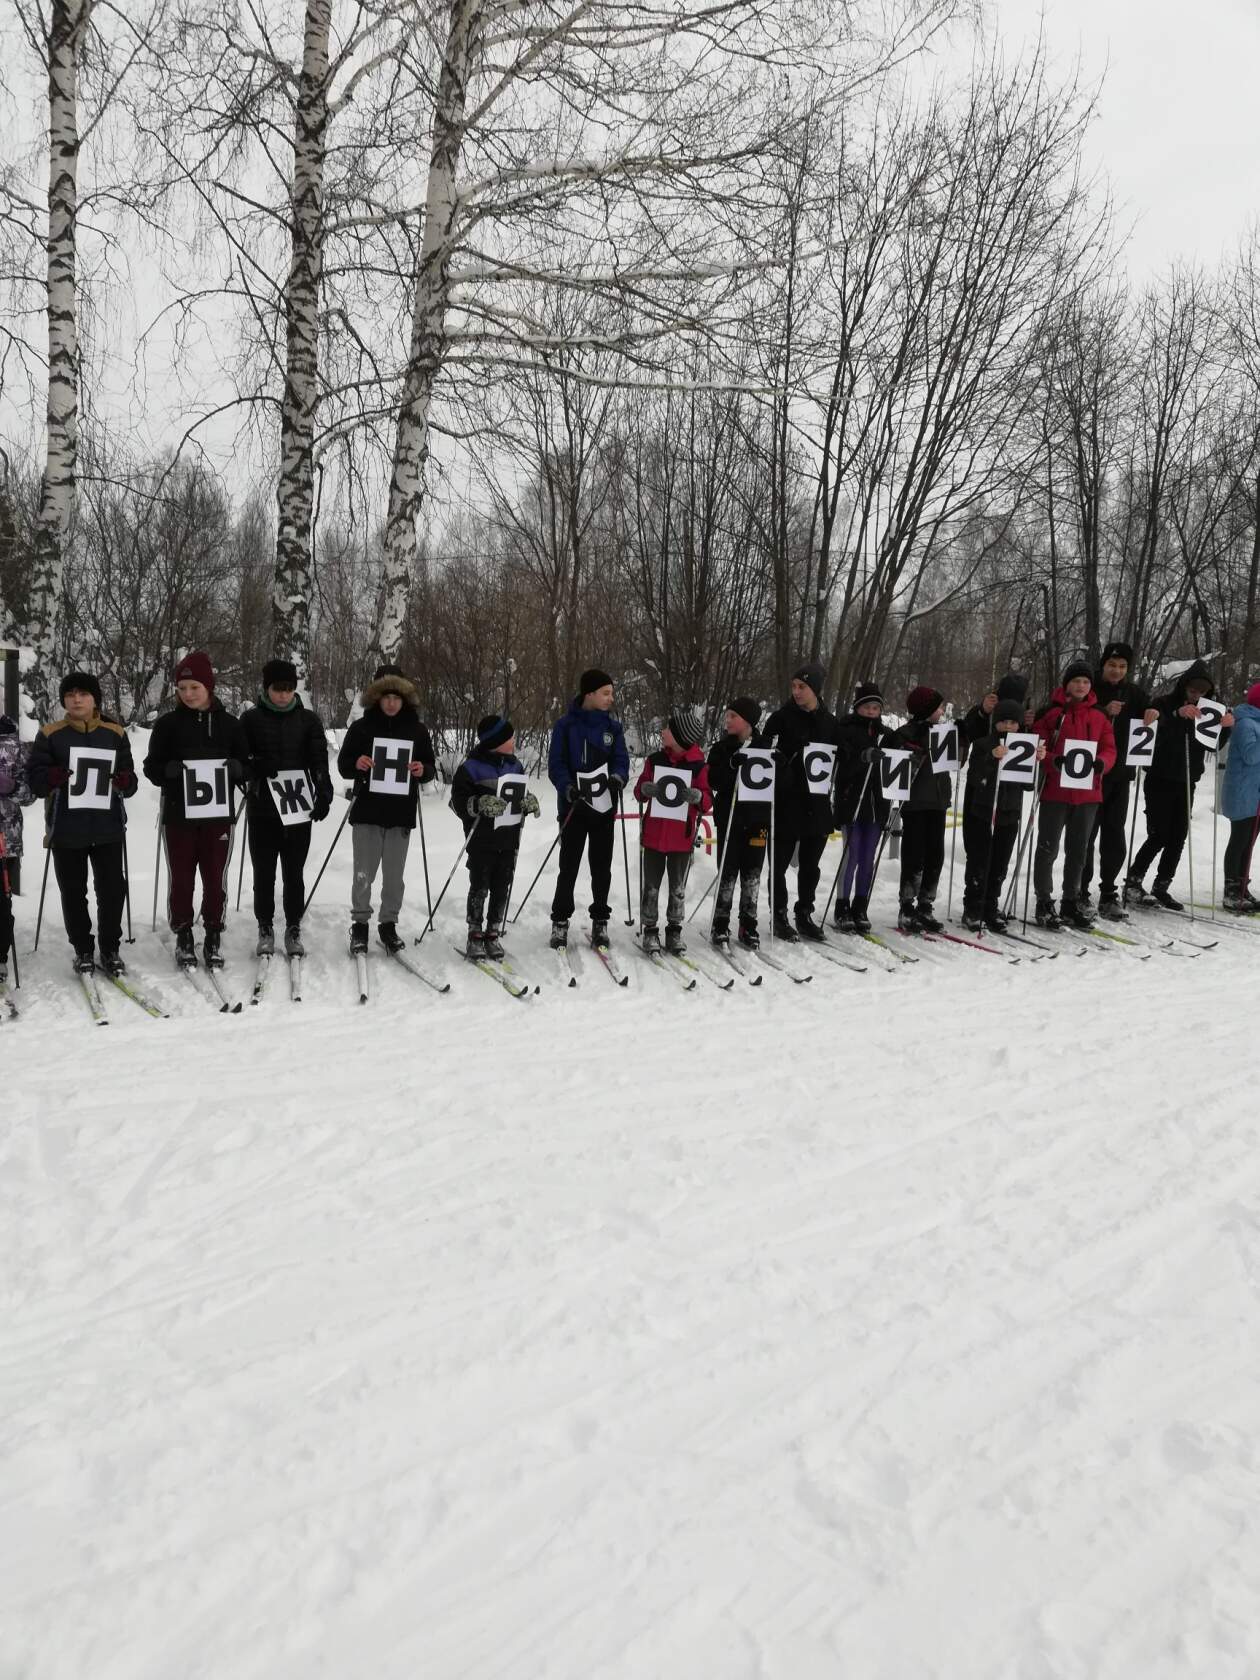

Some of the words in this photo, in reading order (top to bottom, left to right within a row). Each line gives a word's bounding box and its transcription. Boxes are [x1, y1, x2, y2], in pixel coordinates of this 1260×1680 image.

[1196, 708, 1221, 737] 2
[930, 731, 957, 761] И
[1003, 741, 1035, 770] 2
[1130, 728, 1154, 755] 2
[71, 757, 111, 796] Л
[374, 746, 410, 783] Н
[742, 757, 773, 789] С
[805, 751, 831, 781] С
[883, 756, 909, 788] И
[187, 768, 227, 806] Ы
[273, 778, 311, 814] Ж
[501, 783, 525, 815] Я
[578, 774, 607, 806] Р
